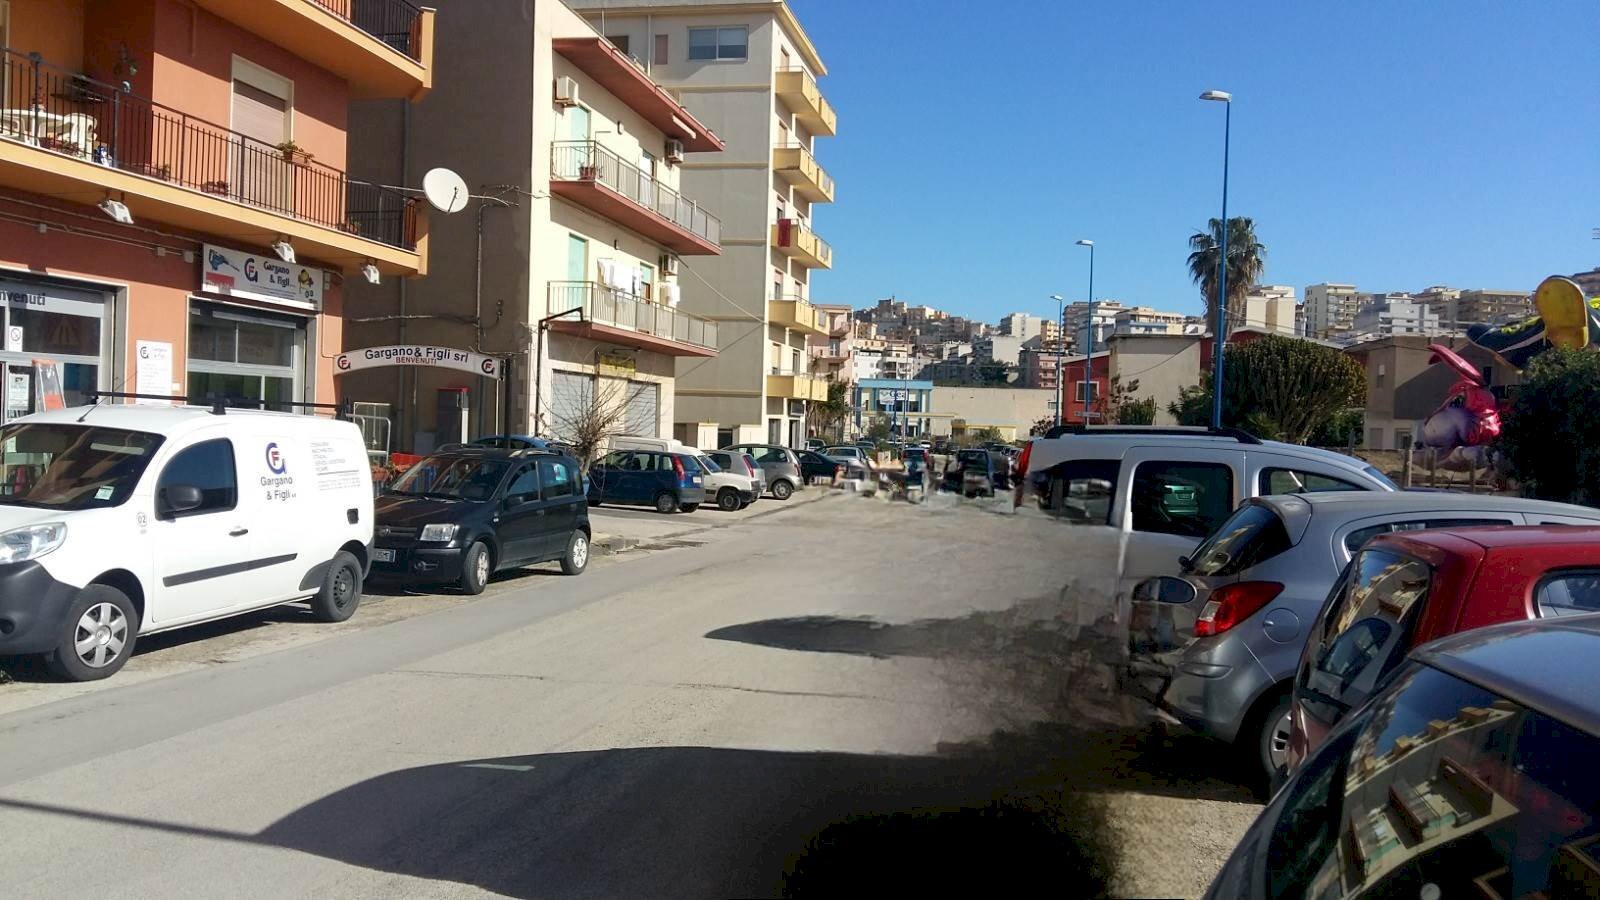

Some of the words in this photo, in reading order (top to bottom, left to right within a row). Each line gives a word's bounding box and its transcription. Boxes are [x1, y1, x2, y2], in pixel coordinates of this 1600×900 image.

[263, 260, 290, 275] Gargano
[395, 356, 437, 365] BENVENUTI
[426, 347, 451, 361] Figli
[453, 352, 469, 363] srl
[260, 476, 293, 488] Gargano
[266, 490, 273, 501] &
[274, 489, 291, 502] Figli
